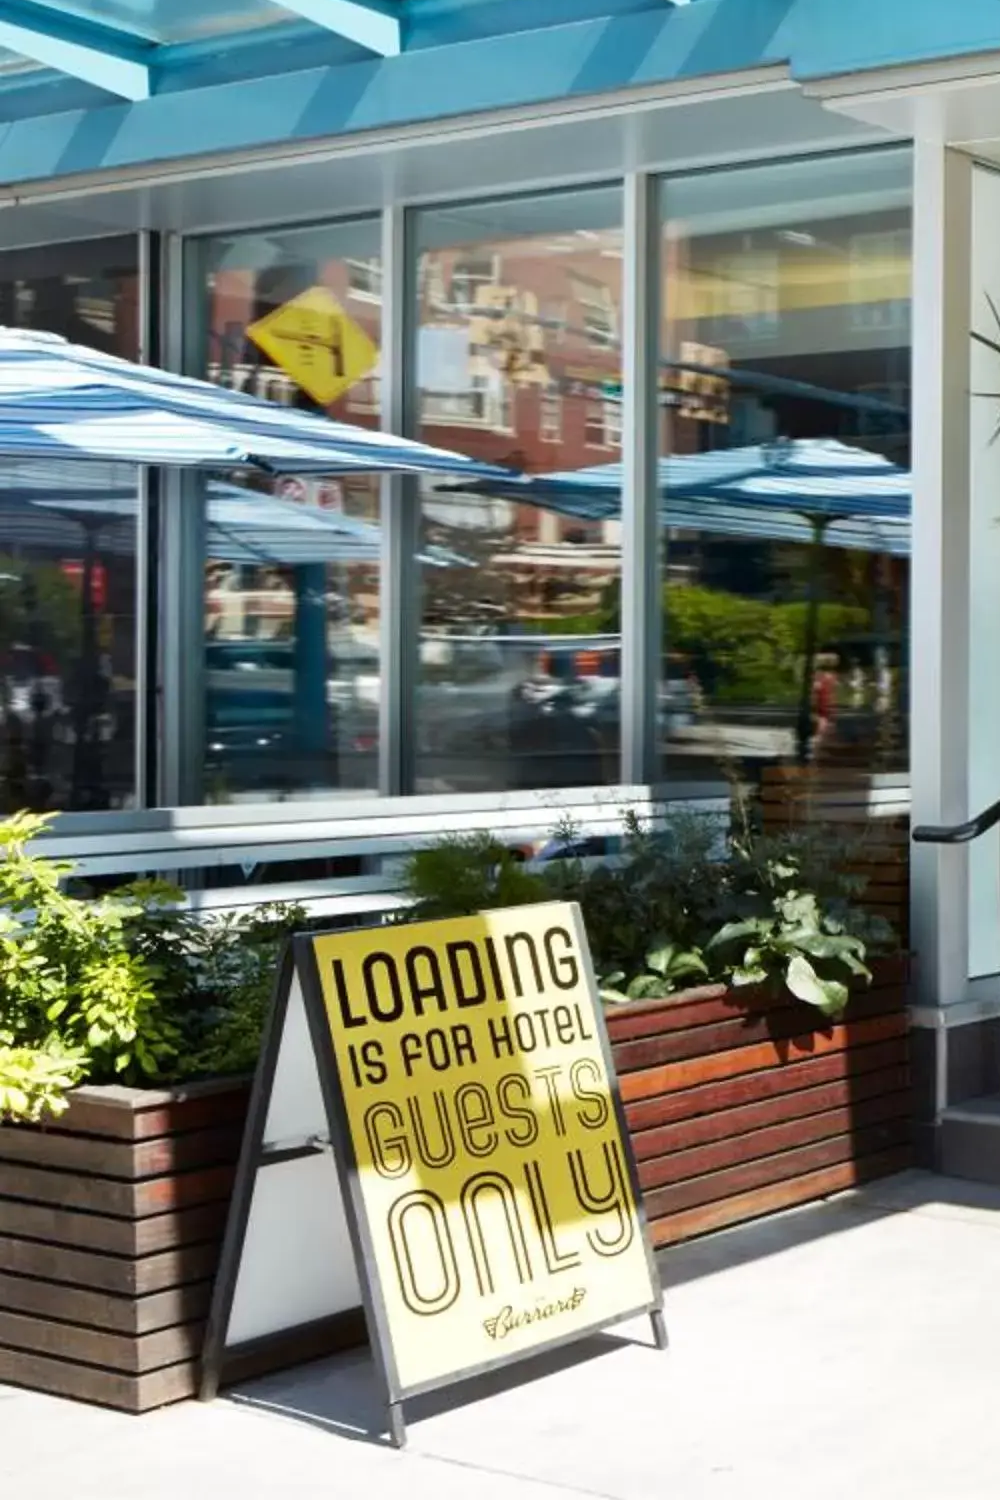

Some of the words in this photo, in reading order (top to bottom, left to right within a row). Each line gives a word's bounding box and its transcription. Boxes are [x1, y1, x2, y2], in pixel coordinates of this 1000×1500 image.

[332, 926, 580, 1028] LOADING
[348, 1039, 388, 1087] IS
[402, 1022, 477, 1076] FOR
[488, 1005, 593, 1059] HOTEL
[363, 1057, 610, 1179] GUESTS
[483, 1287, 587, 1339] Burrard
